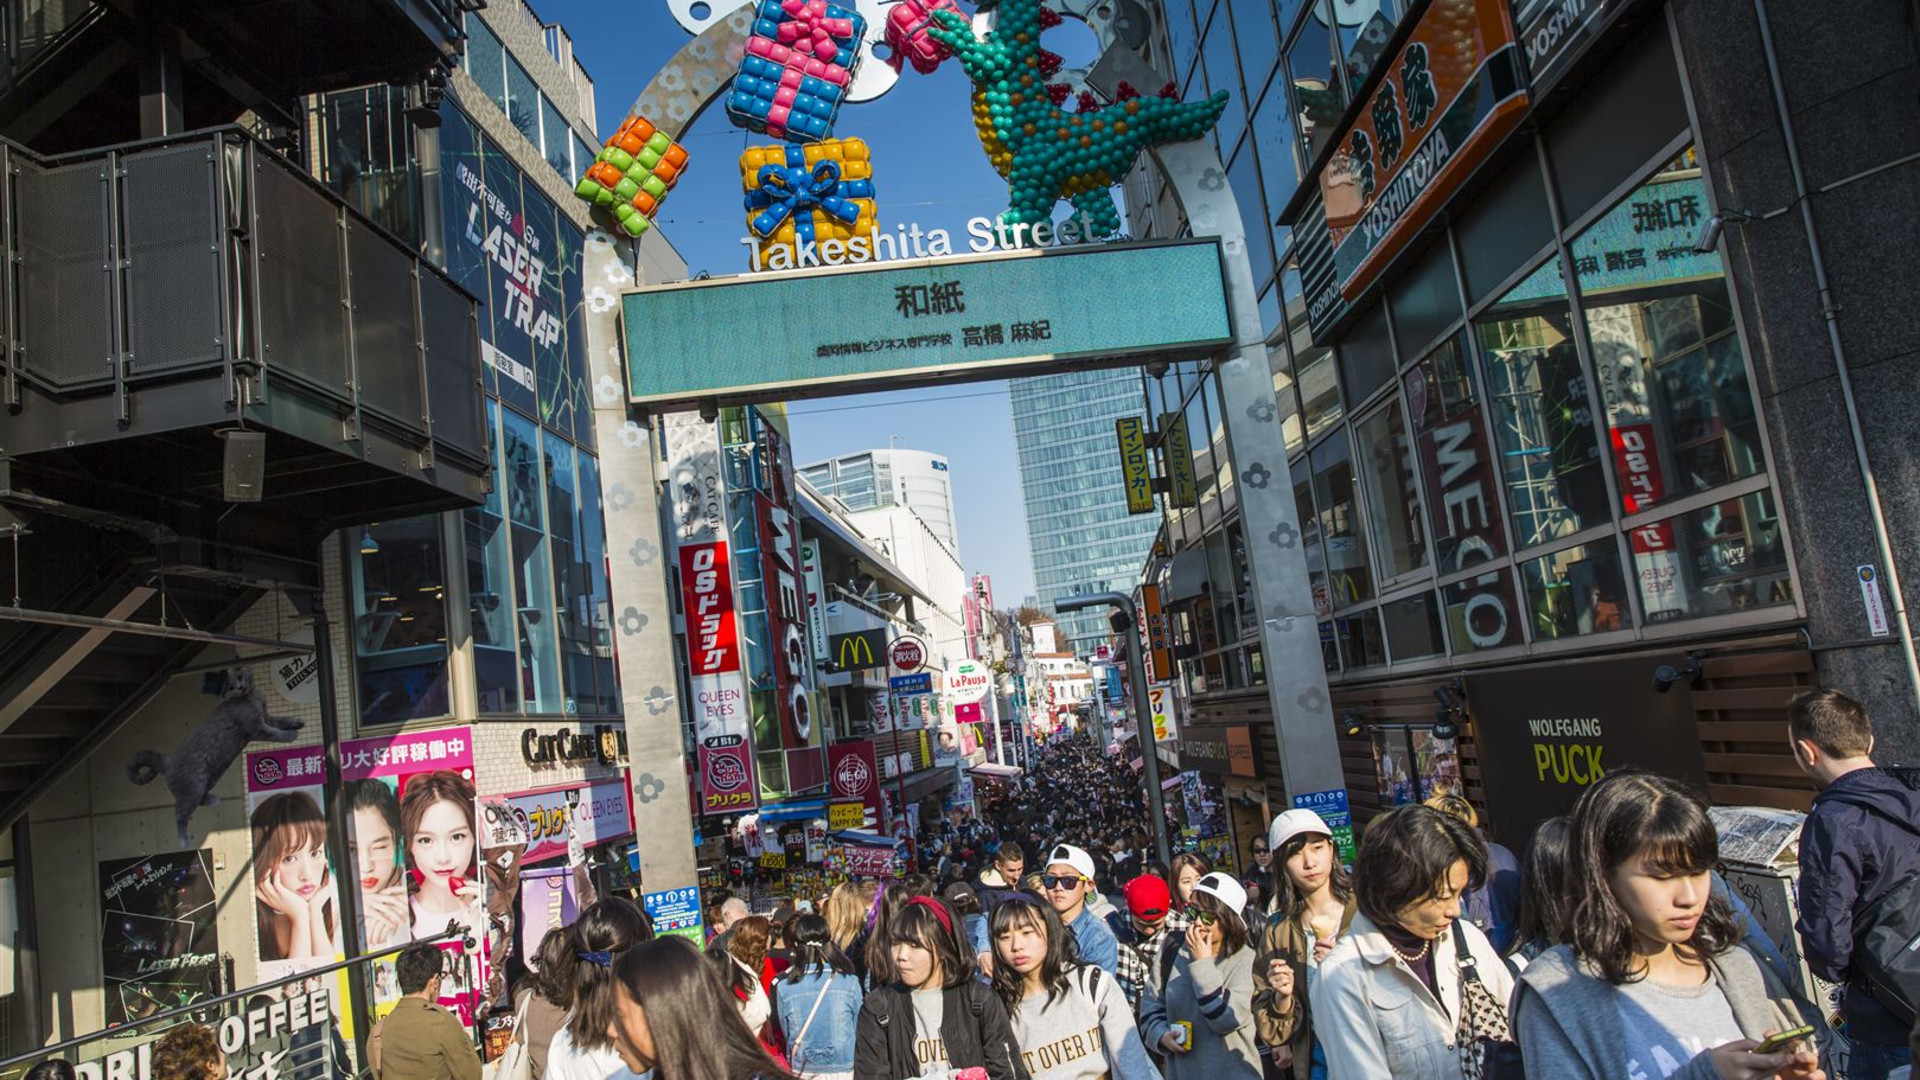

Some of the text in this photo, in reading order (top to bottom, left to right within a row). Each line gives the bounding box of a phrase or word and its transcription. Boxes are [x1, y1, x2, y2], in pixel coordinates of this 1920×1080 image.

[1363, 128, 1450, 250] YOSHINOYA
[465, 202, 544, 297] LASER
[740, 210, 1099, 273] Takeshita Street
[894, 280, 965, 318] 和紙
[503, 278, 561, 349] TRAP
[961, 323, 1004, 349] 高橋
[1010, 319, 1052, 343] 麻紀
[1123, 419, 1146, 500] コインロッカー
[705, 475, 717, 501] CAT
[894, 649, 920, 664] 消火栓
[950, 675, 987, 688] La Pausa
[698, 688, 740, 704] QUEEN
[706, 703, 735, 718] EYES
[1529, 718, 1602, 737] WOLFGANG
[286, 738, 465, 777] 最新リ大好評稼働中
[1534, 743, 1605, 785] PUCK
[580, 797, 624, 821] QUEEN EYES
[706, 793, 752, 807] プリクラ
[831, 807, 862, 817] ハッピーワン
[492, 827, 518, 844] 営中
[137, 952, 217, 974] LASER TRAP
[220, 989, 328, 1054] OFFEE
[918, 1038, 948, 1064] OVE
[1038, 1036, 1087, 1069] OVER
